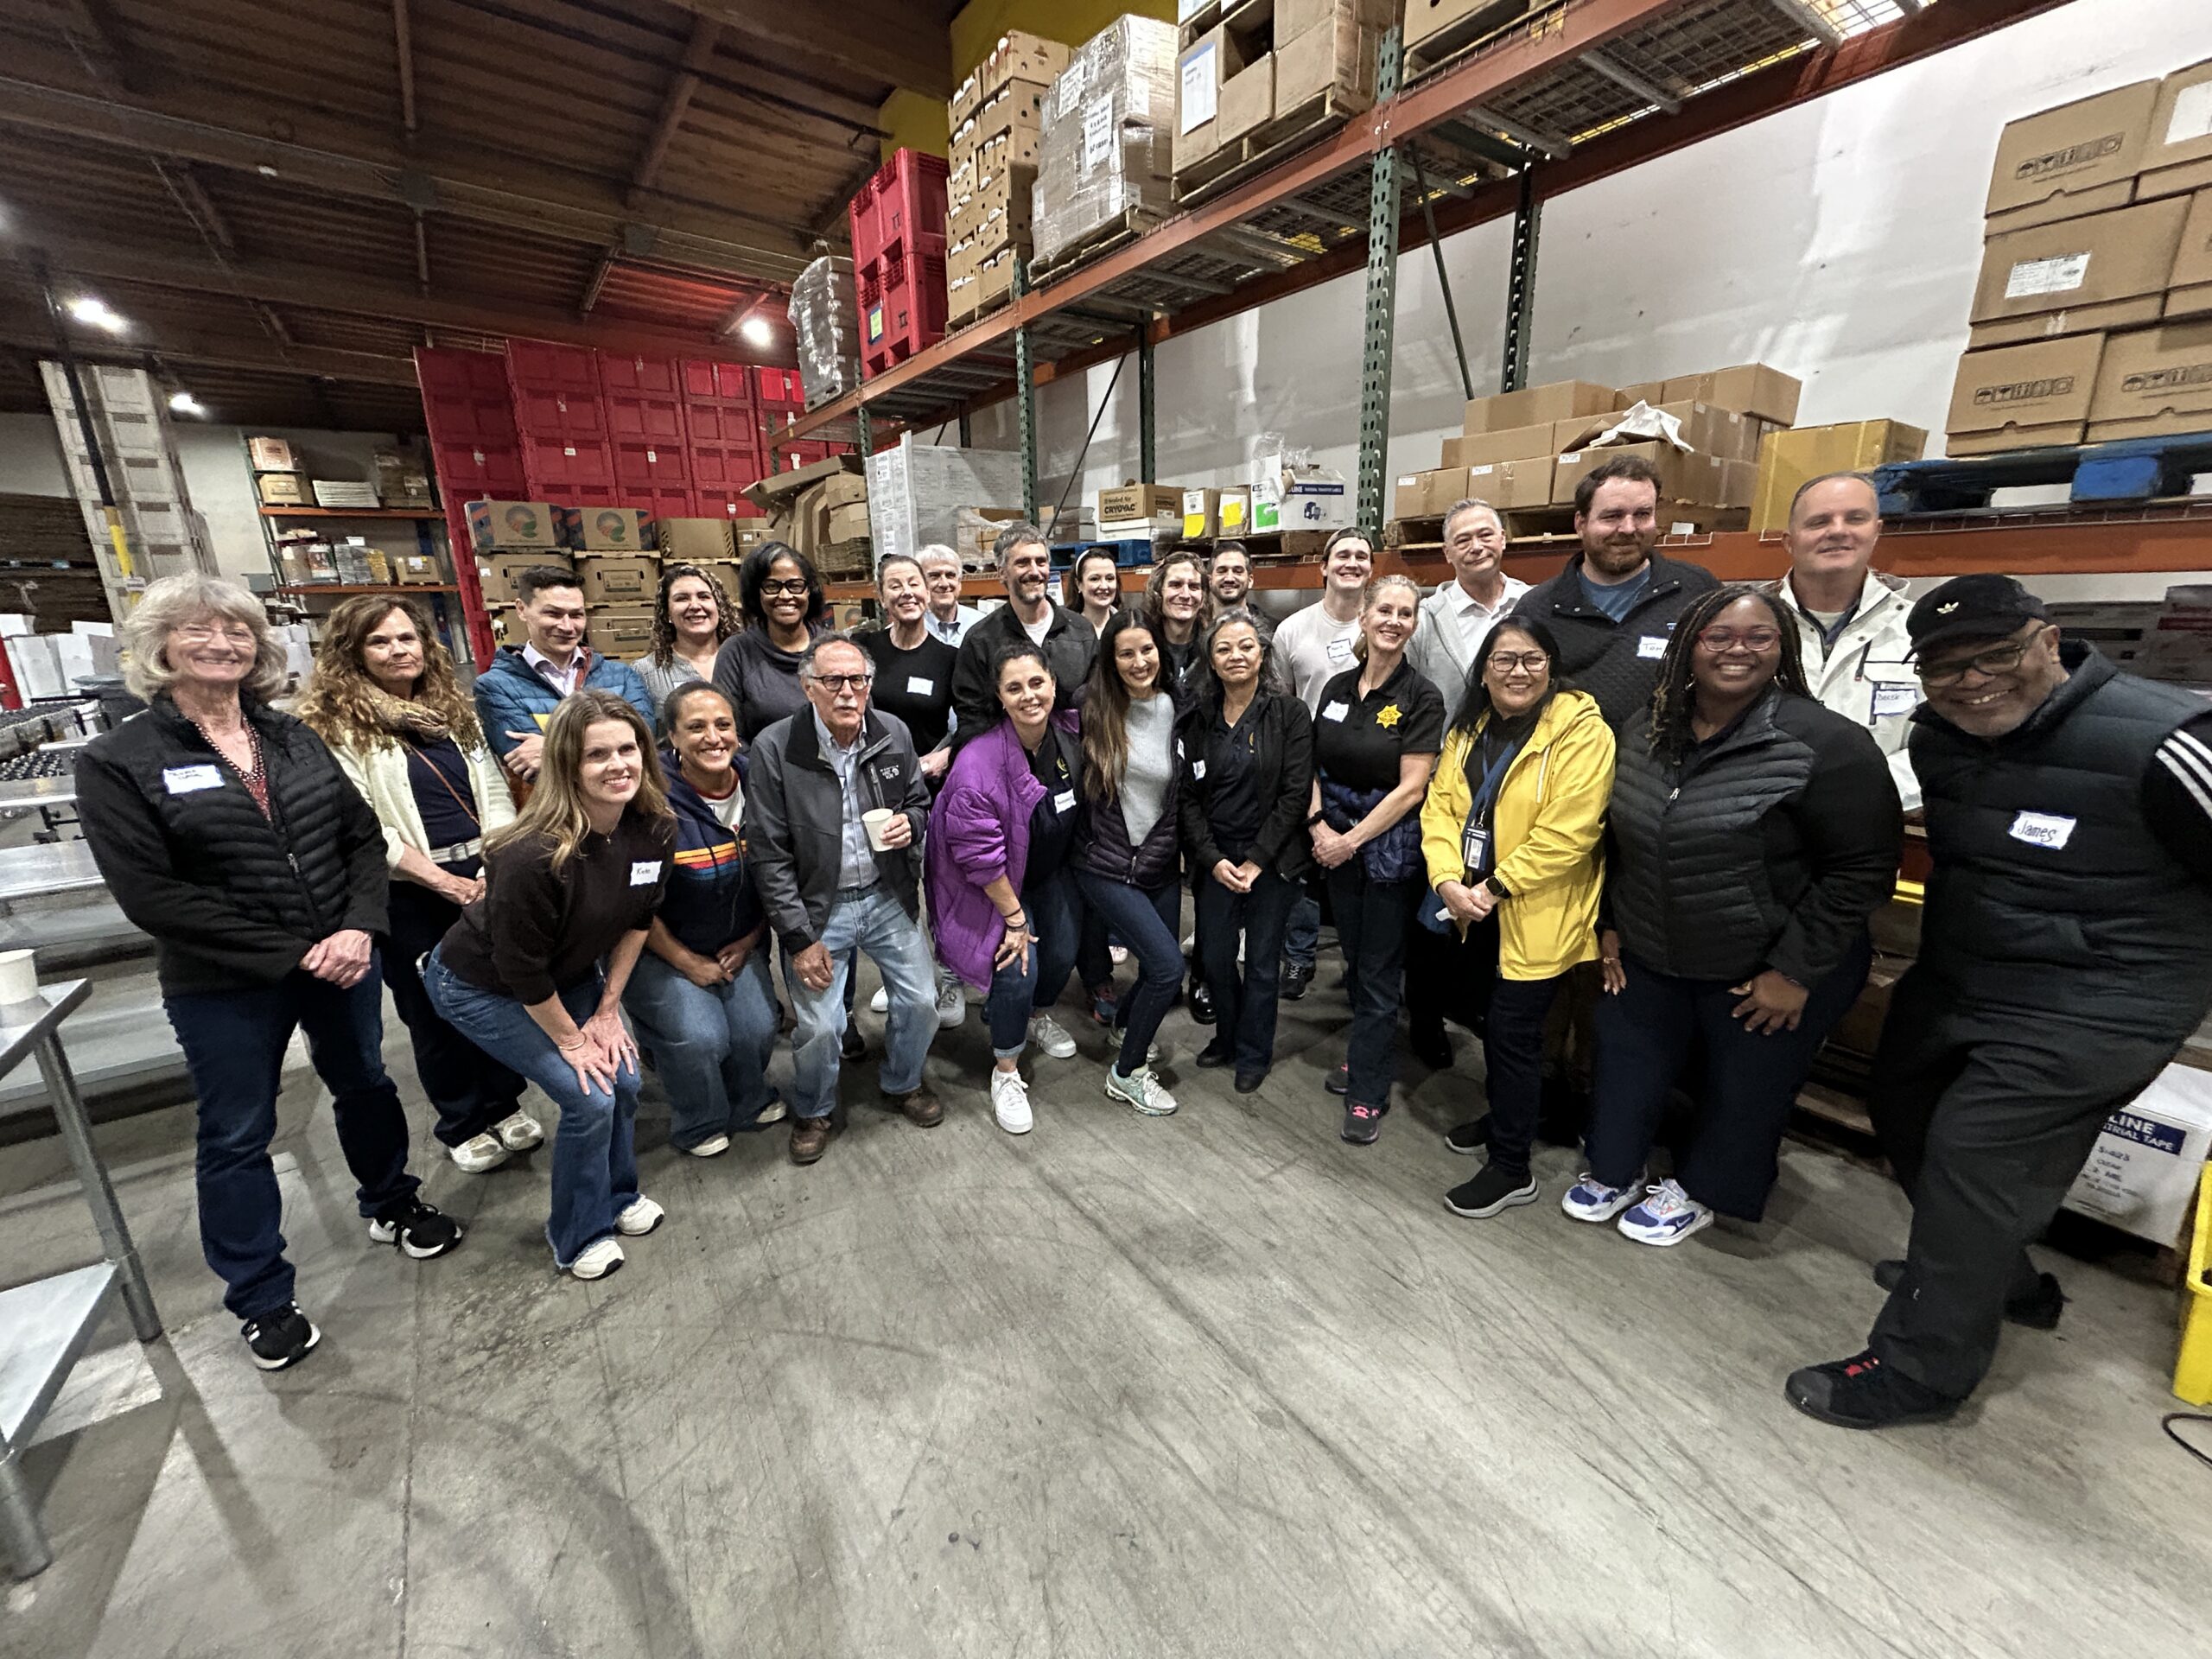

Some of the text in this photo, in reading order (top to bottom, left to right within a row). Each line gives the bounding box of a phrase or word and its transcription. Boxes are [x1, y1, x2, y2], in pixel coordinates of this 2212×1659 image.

[1104, 504, 1135, 514] CRYOVAC
[2017, 820, 2056, 842] James
[2143, 1135, 2174, 1151] TAPE
